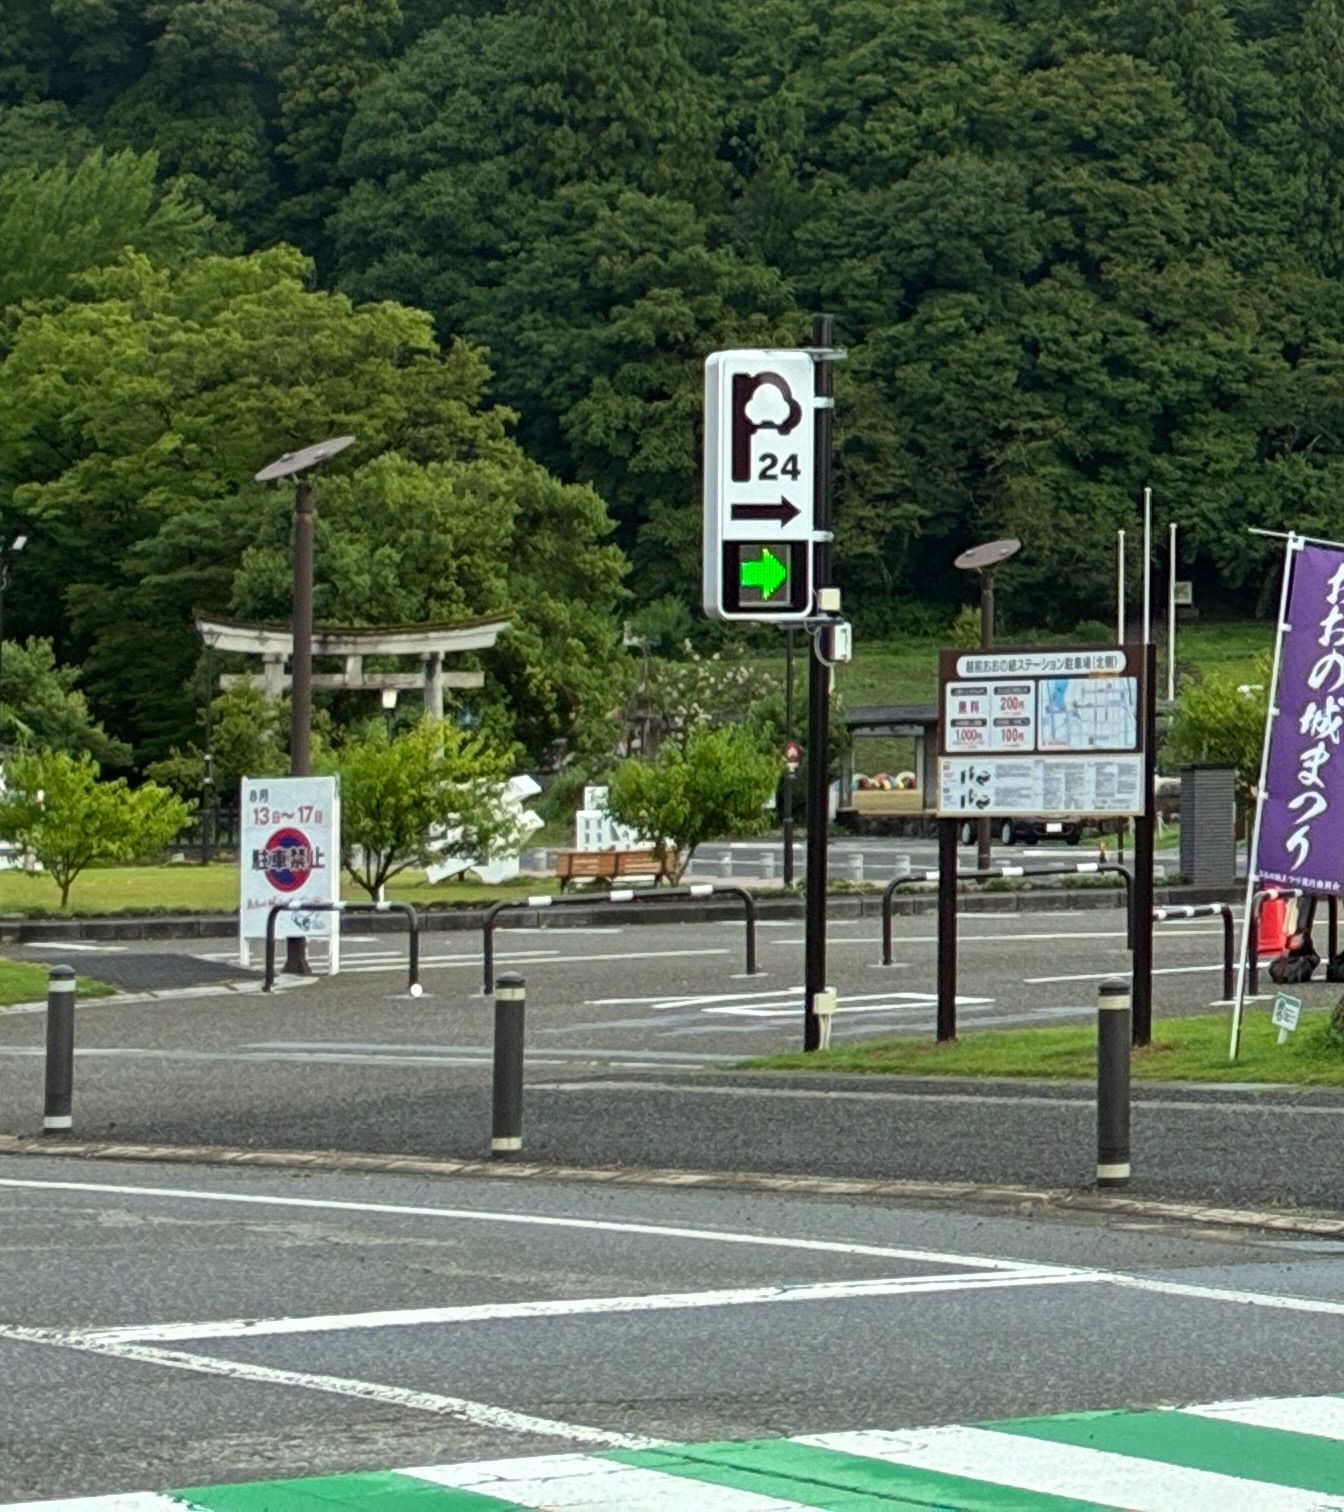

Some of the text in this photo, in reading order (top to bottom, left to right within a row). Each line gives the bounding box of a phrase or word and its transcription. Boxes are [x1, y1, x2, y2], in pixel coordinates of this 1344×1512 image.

[758, 453, 801, 481] 24
[249, 788, 269, 803] 8月
[252, 845, 326, 870] 駐車禁止
